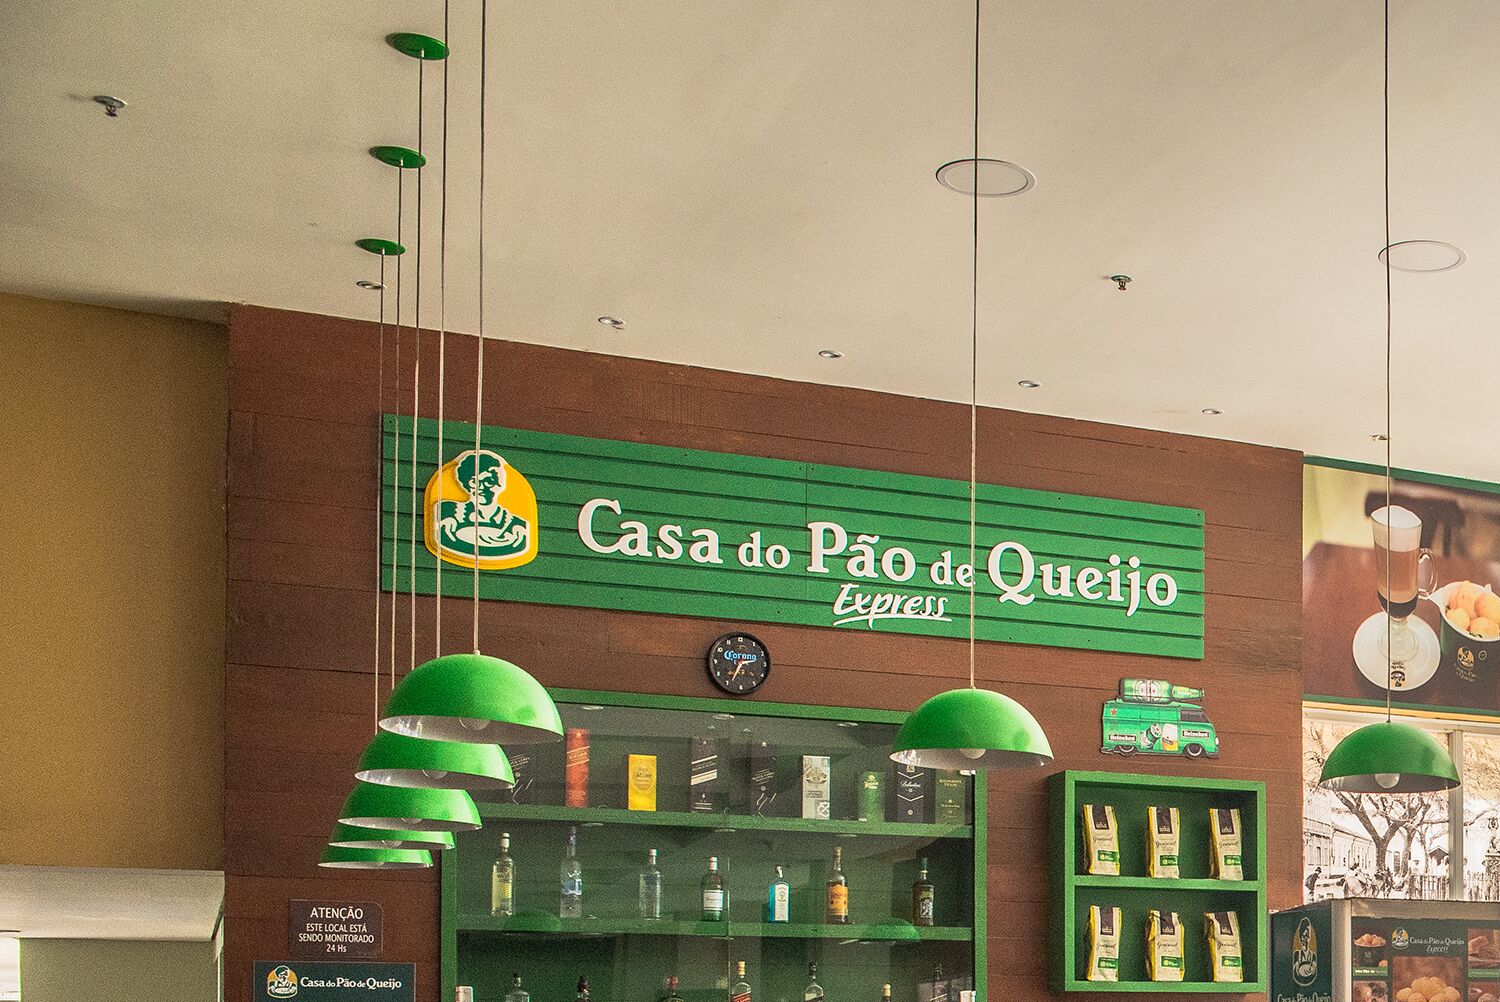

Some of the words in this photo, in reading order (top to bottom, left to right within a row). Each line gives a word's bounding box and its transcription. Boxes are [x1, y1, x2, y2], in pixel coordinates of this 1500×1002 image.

[577, 498, 723, 564] Casa
[737, 531, 791, 569] do
[806, 521, 916, 582] Pão
[930, 551, 975, 587] de
[987, 541, 1178, 617] Queijo
[833, 583, 952, 629] Express
[724, 650, 757, 661] Corona
[310, 906, 364, 921] ATENÇÃO
[306, 923, 323, 932] ESTE
[324, 923, 348, 932] LOCAL
[349, 922, 367, 933] ESTÁ
[298, 933, 323, 942] SENDO
[325, 934, 375, 943] MONITORADO
[326, 944, 336, 953] 24
[337, 944, 347, 953] Hs
[300, 976, 325, 987] Casa
[325, 980, 336, 988] do
[336, 977, 357, 988] Pão
[356, 980, 366, 988] de
[366, 977, 402, 990] Queijo
